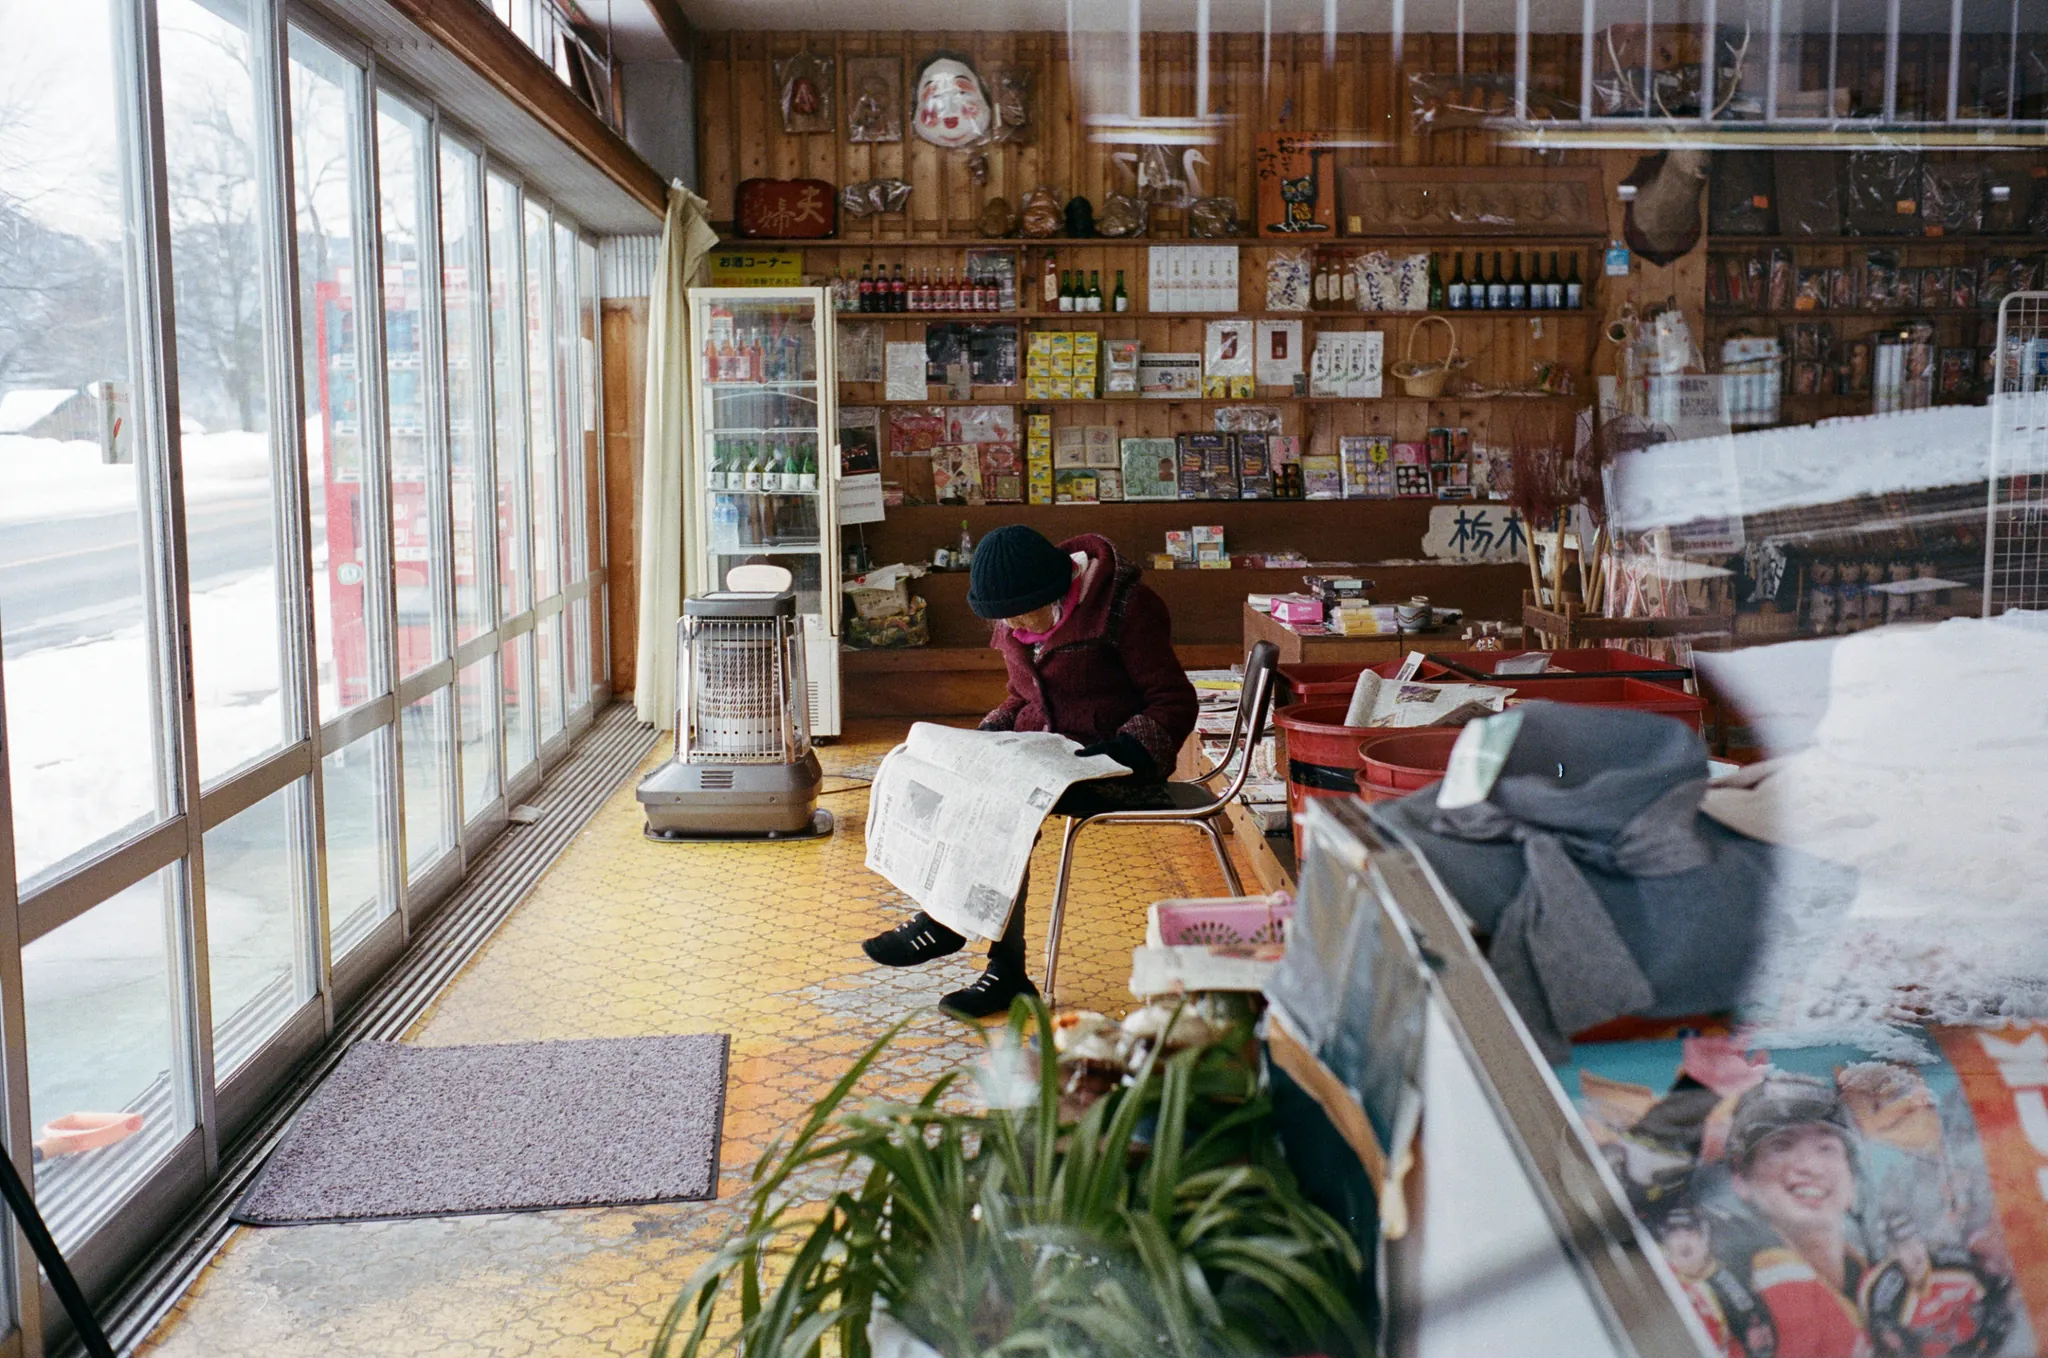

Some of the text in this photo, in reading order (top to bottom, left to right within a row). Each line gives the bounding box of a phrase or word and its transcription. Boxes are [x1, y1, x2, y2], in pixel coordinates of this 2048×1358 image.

[719, 256, 792, 268] お酒コーナー
